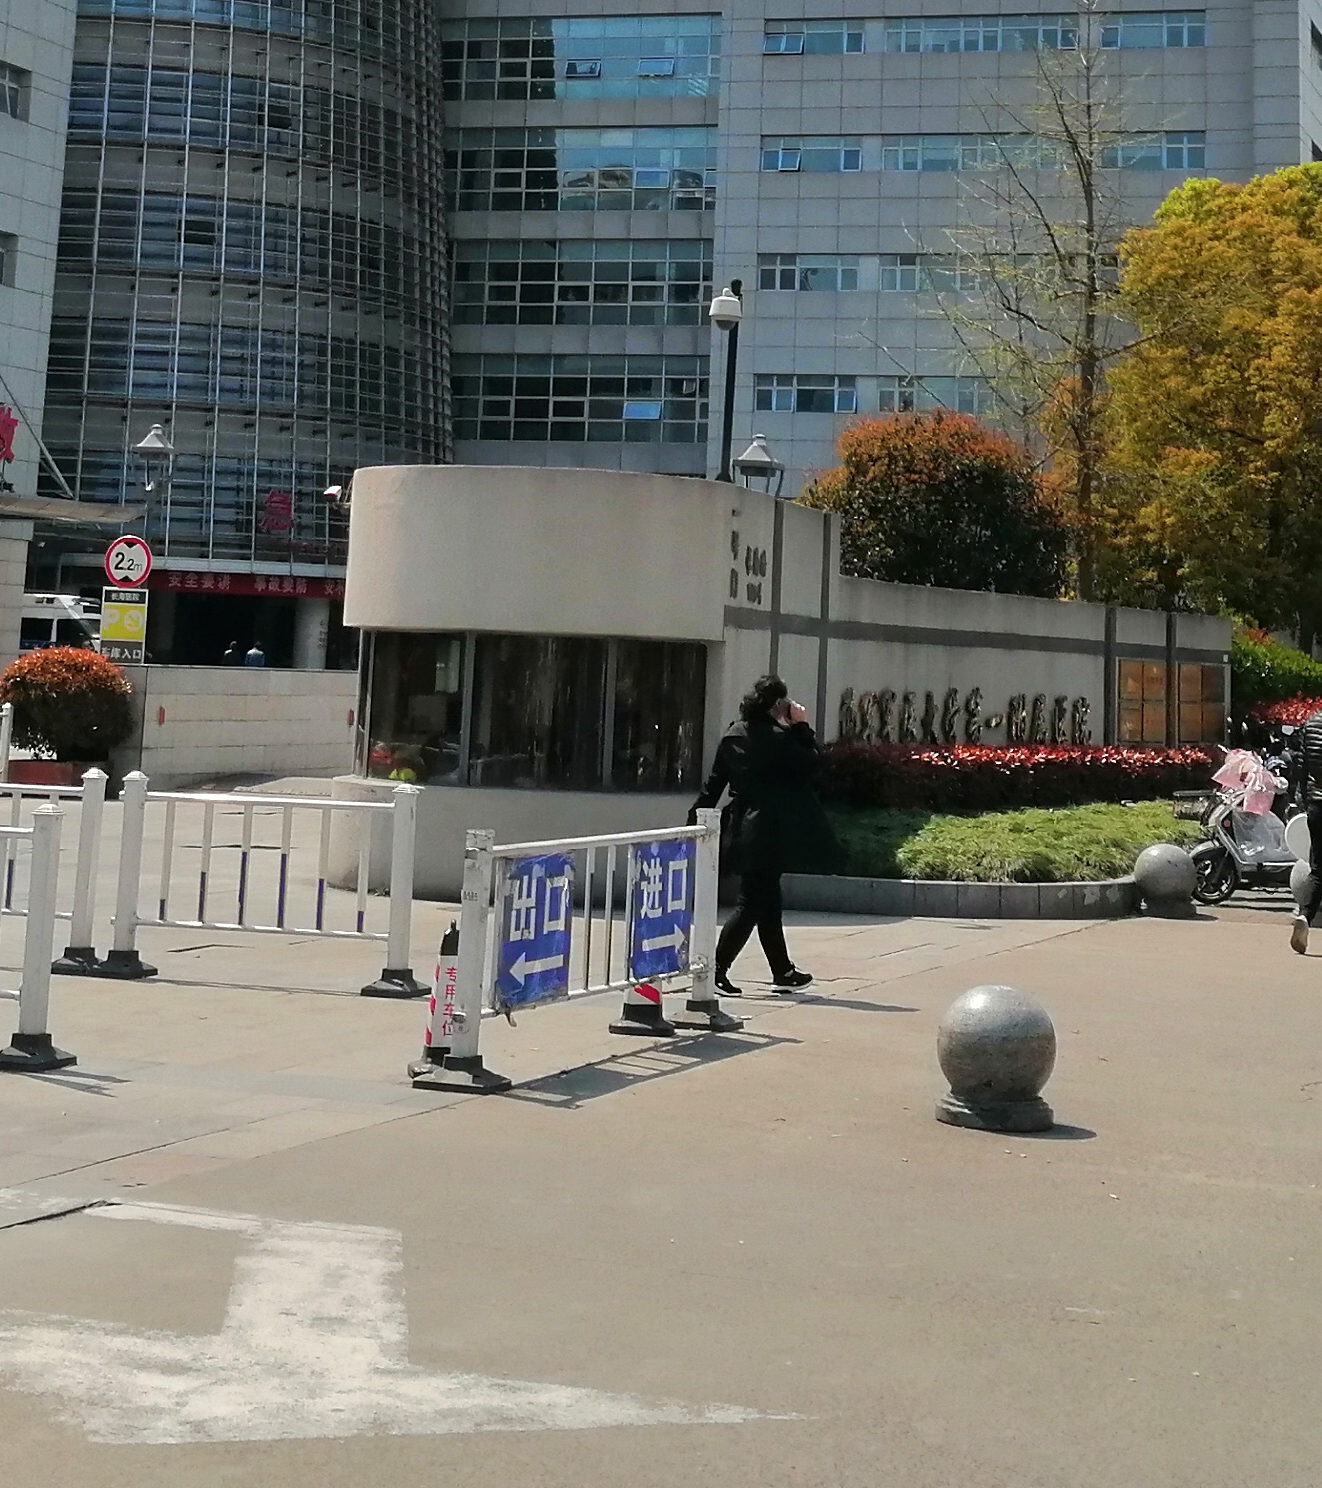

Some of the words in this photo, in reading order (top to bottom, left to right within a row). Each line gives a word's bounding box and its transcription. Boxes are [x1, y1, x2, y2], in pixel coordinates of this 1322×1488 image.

[114, 552, 143, 571] 2.2m
[510, 874, 566, 942] 出口
[639, 857, 688, 919] 进口
